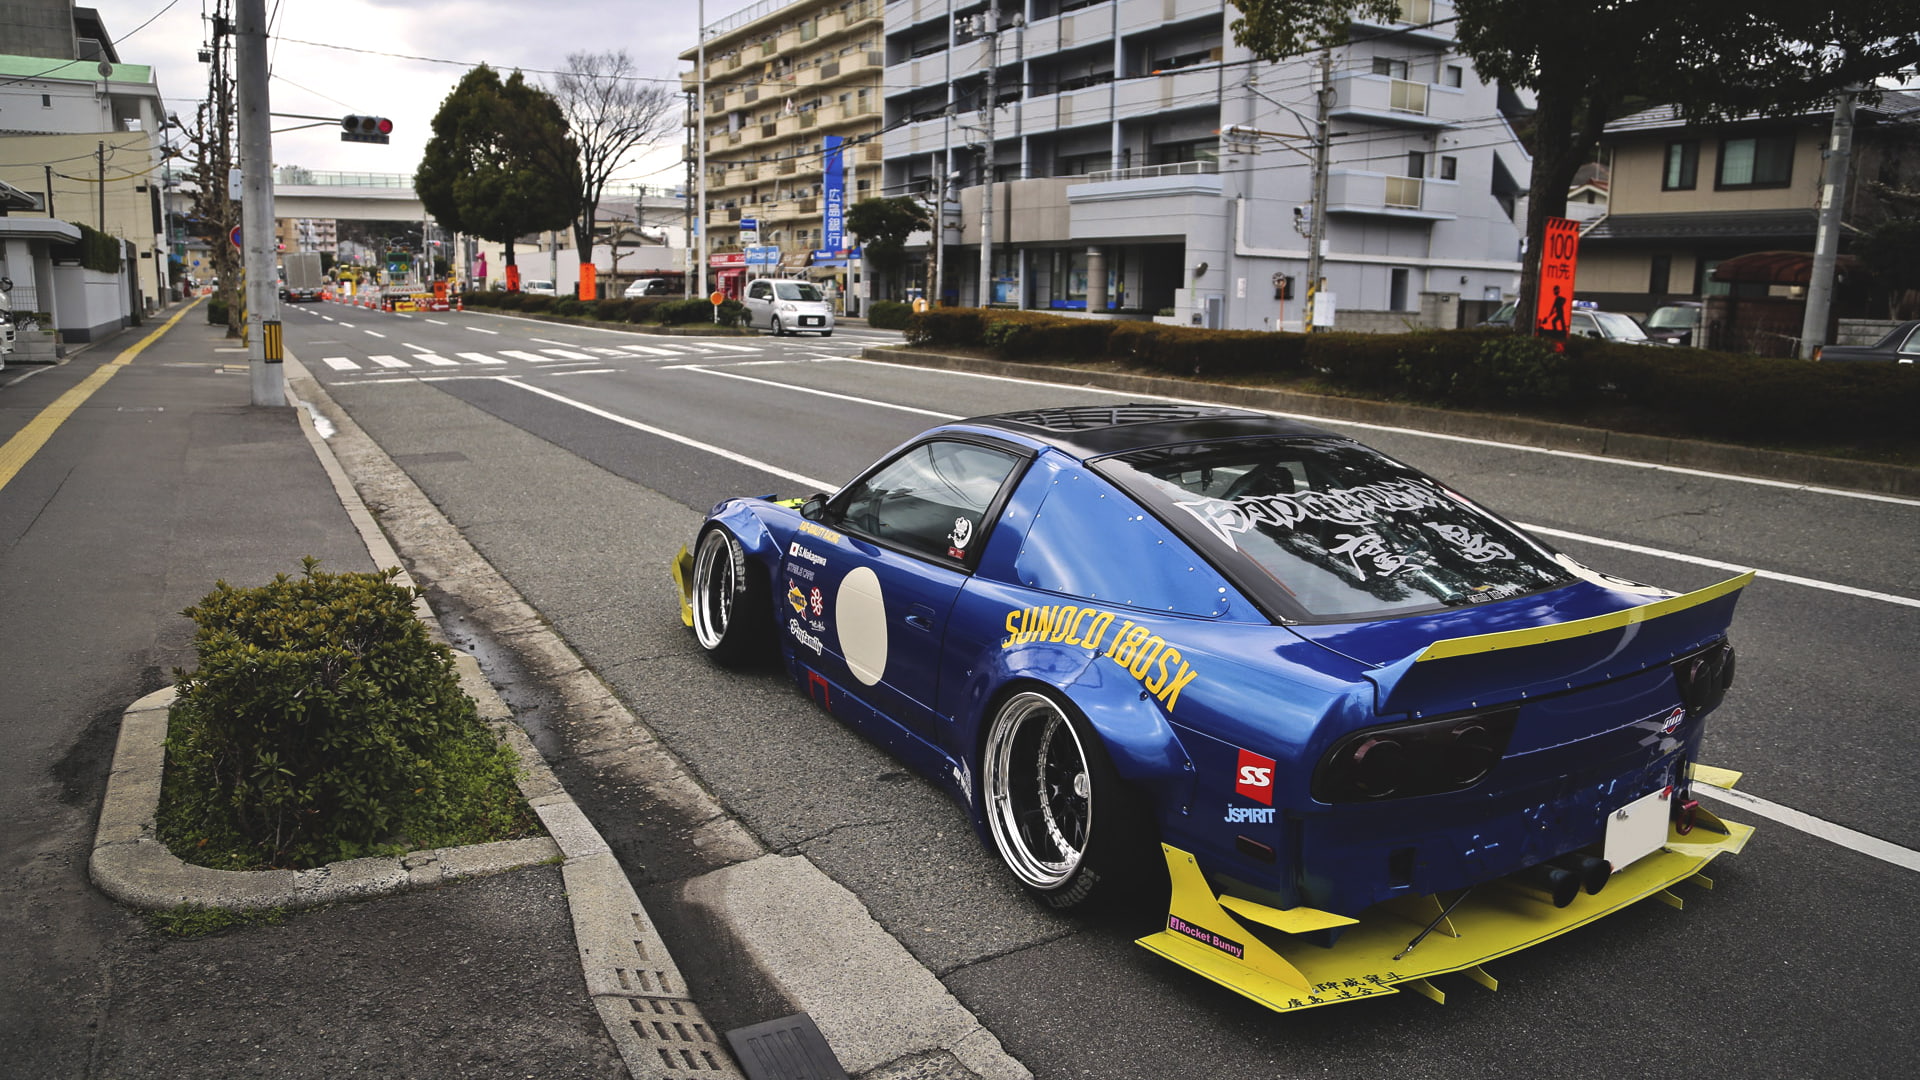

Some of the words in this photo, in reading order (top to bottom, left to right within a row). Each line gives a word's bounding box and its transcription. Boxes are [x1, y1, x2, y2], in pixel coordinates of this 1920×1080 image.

[828, 188, 841, 247] 広島銀行
[1549, 233, 1574, 260] 100
[798, 546, 827, 567] S.Nakagawa
[1001, 605, 1115, 650] SUNOCO
[1104, 620, 1198, 713] 180SX
[1239, 765, 1271, 787] SS
[1180, 922, 1211, 943] Rocket
[1213, 936, 1242, 957] Bunny
